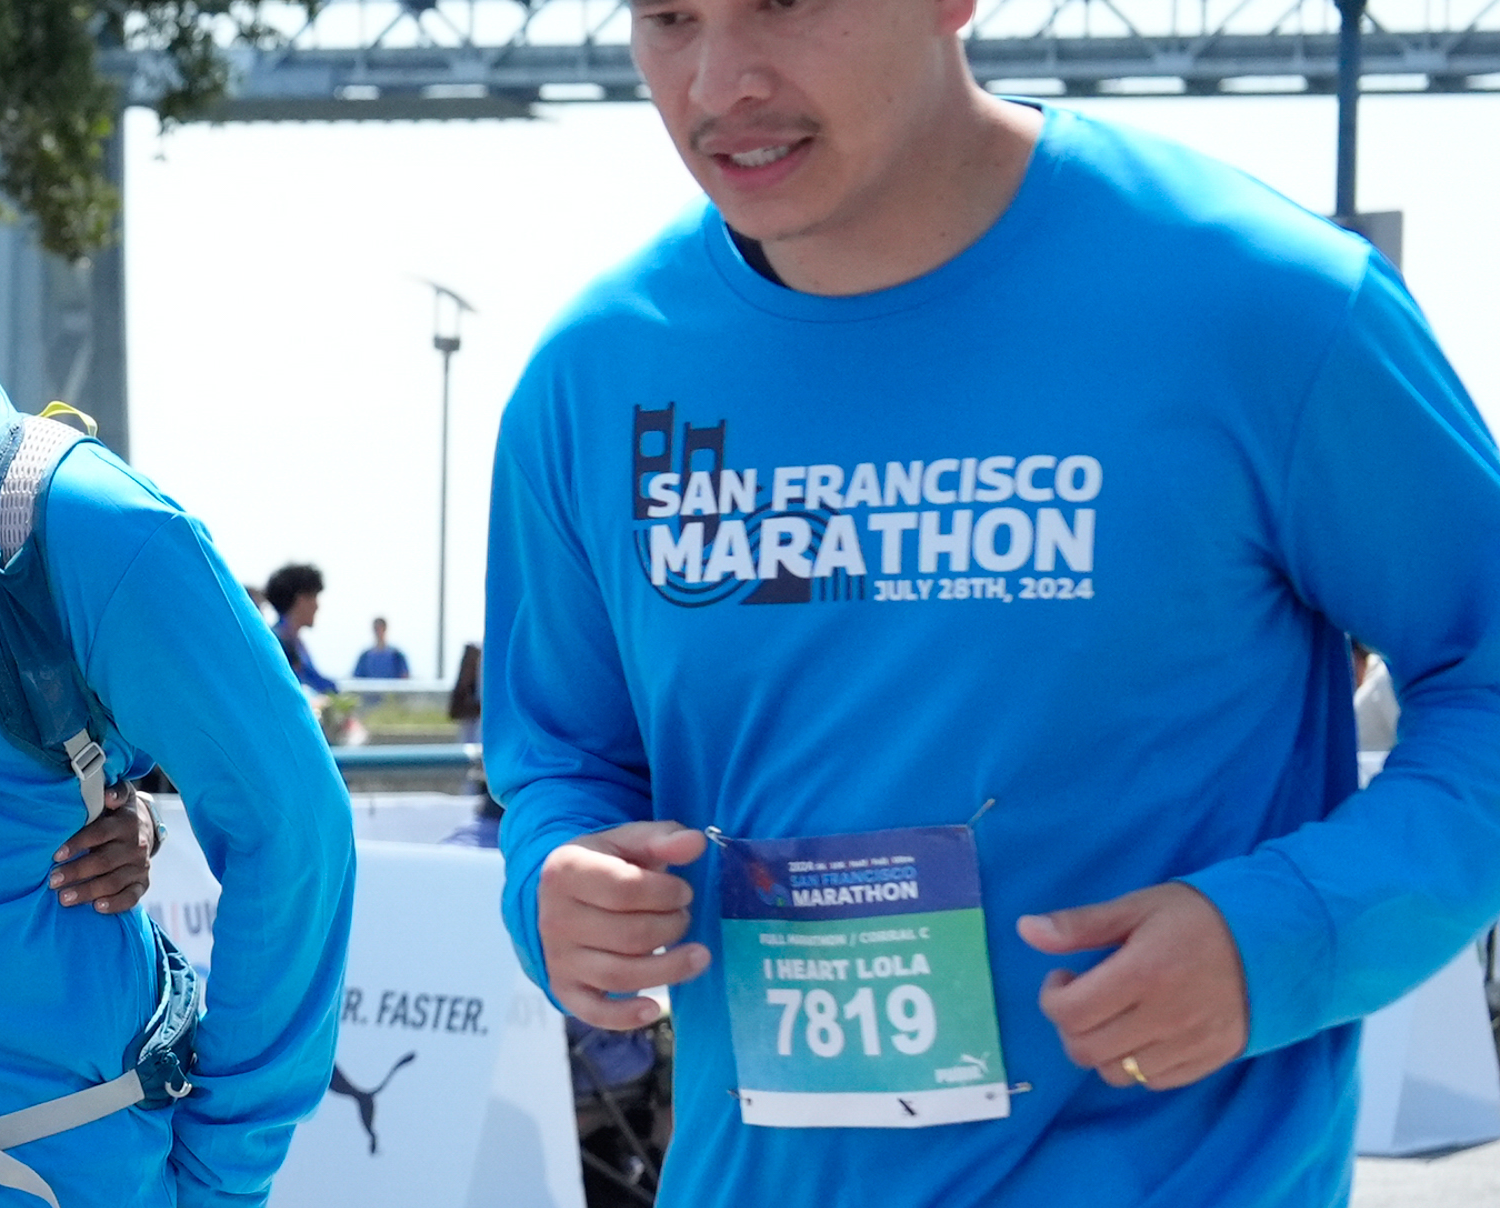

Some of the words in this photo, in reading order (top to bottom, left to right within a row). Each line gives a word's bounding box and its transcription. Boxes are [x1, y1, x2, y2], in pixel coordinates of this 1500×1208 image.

[647, 468, 757, 517] SAN
[771, 455, 1103, 512] FRANCISCO
[649, 507, 1096, 586] MARATHON
[874, 579, 934, 601] JULY
[937, 578, 1012, 603] 28TH,
[1018, 577, 1095, 599] 2024
[791, 881, 920, 907] MARATHON
[763, 958, 773, 980] I
[776, 958, 849, 981] HEART
[856, 953, 931, 979] LOLA
[376, 989, 488, 1036] FASTER.
[766, 984, 937, 1057] 7819
